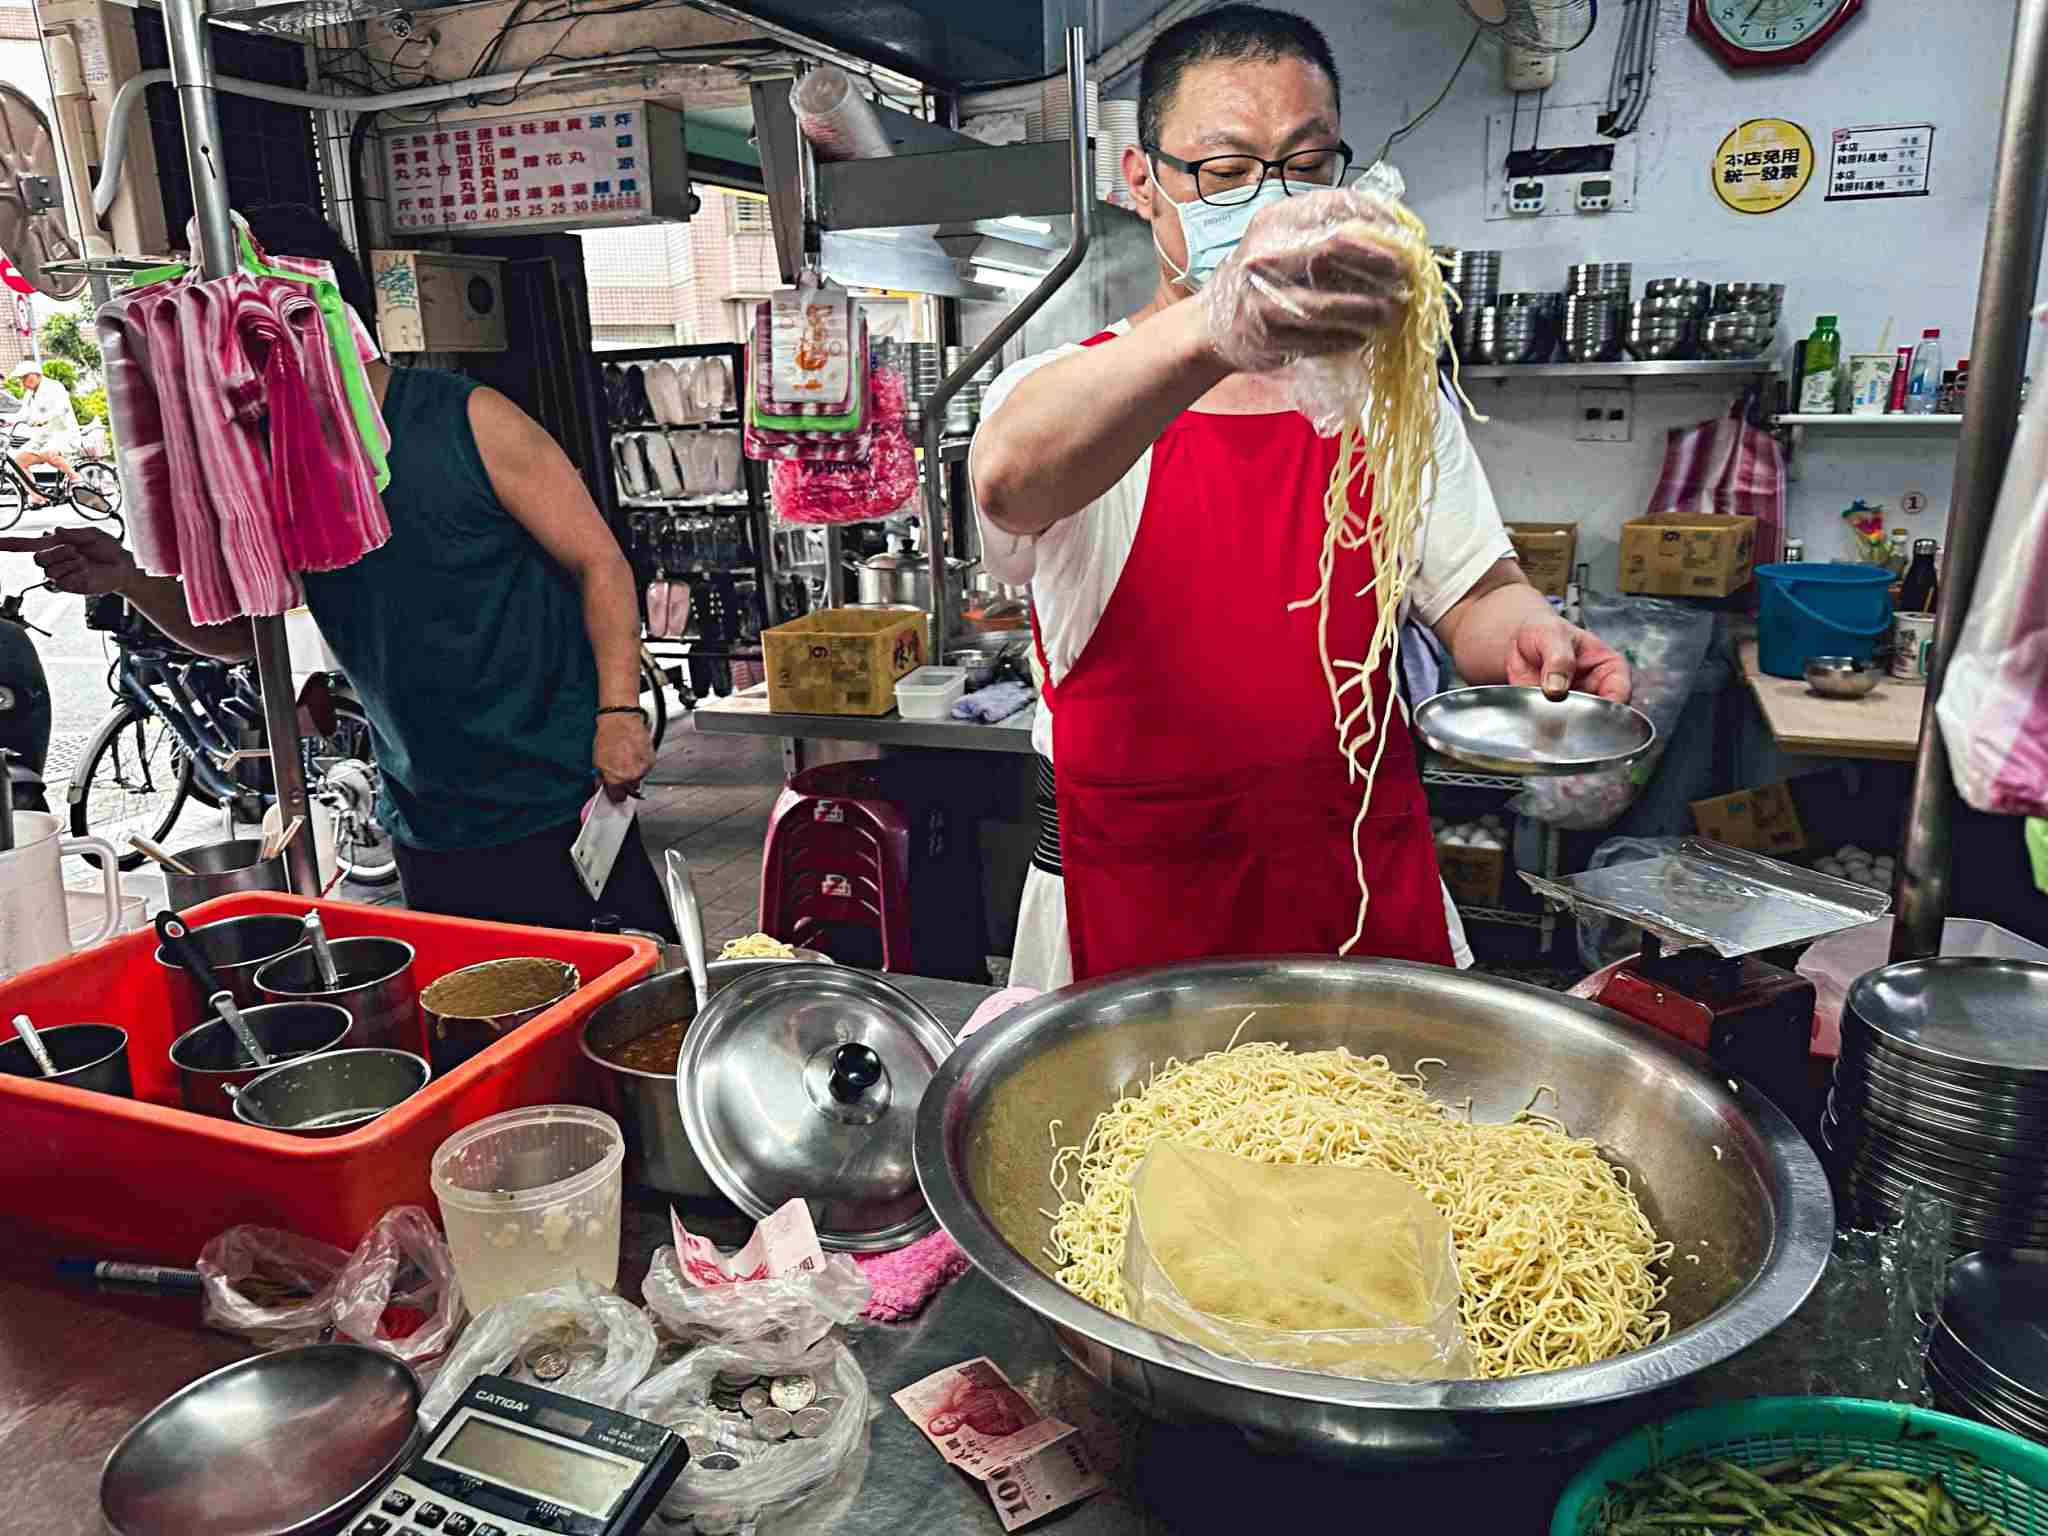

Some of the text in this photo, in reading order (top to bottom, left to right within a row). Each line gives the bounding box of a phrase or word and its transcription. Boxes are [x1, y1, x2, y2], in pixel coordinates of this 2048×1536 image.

[1721, 8, 1735, 20] 8
[1739, 23, 1750, 38] 7
[1792, 17, 1805, 32] 5
[1765, 27, 1777, 40] 6
[1725, 148, 1800, 167] 本店免用
[1723, 164, 1798, 184] 統一發票
[506, 206, 521, 218] 35
[528, 204, 545, 216] 25
[551, 202, 567, 214] 25
[573, 200, 589, 212] 30
[464, 209, 478, 221] 40
[485, 207, 499, 220] 40
[475, 1390, 524, 1412] CATIGA
